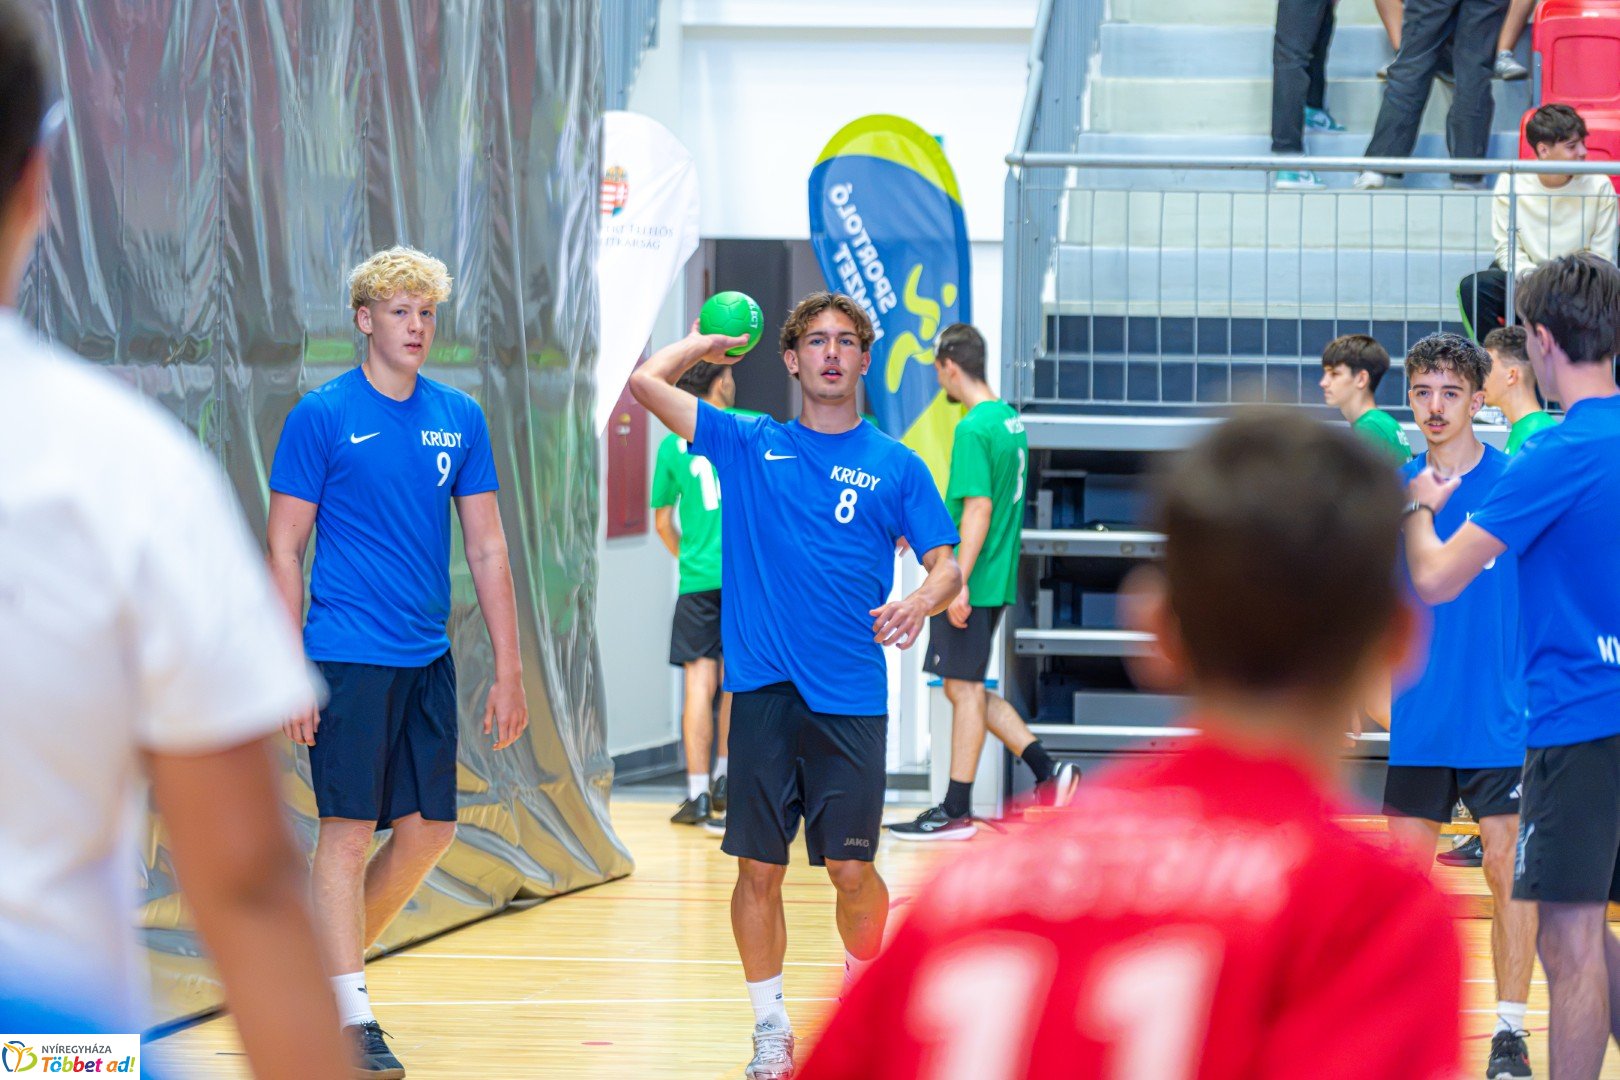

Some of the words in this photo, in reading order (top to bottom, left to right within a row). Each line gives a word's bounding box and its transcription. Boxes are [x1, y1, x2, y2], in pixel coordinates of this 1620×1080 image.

[421, 428, 462, 449] KRÚDY
[436, 451, 452, 487] 9
[689, 454, 722, 512] 1
[830, 465, 881, 492] KRÚDY
[834, 487, 858, 524] 8
[904, 928, 1226, 1080] 11
